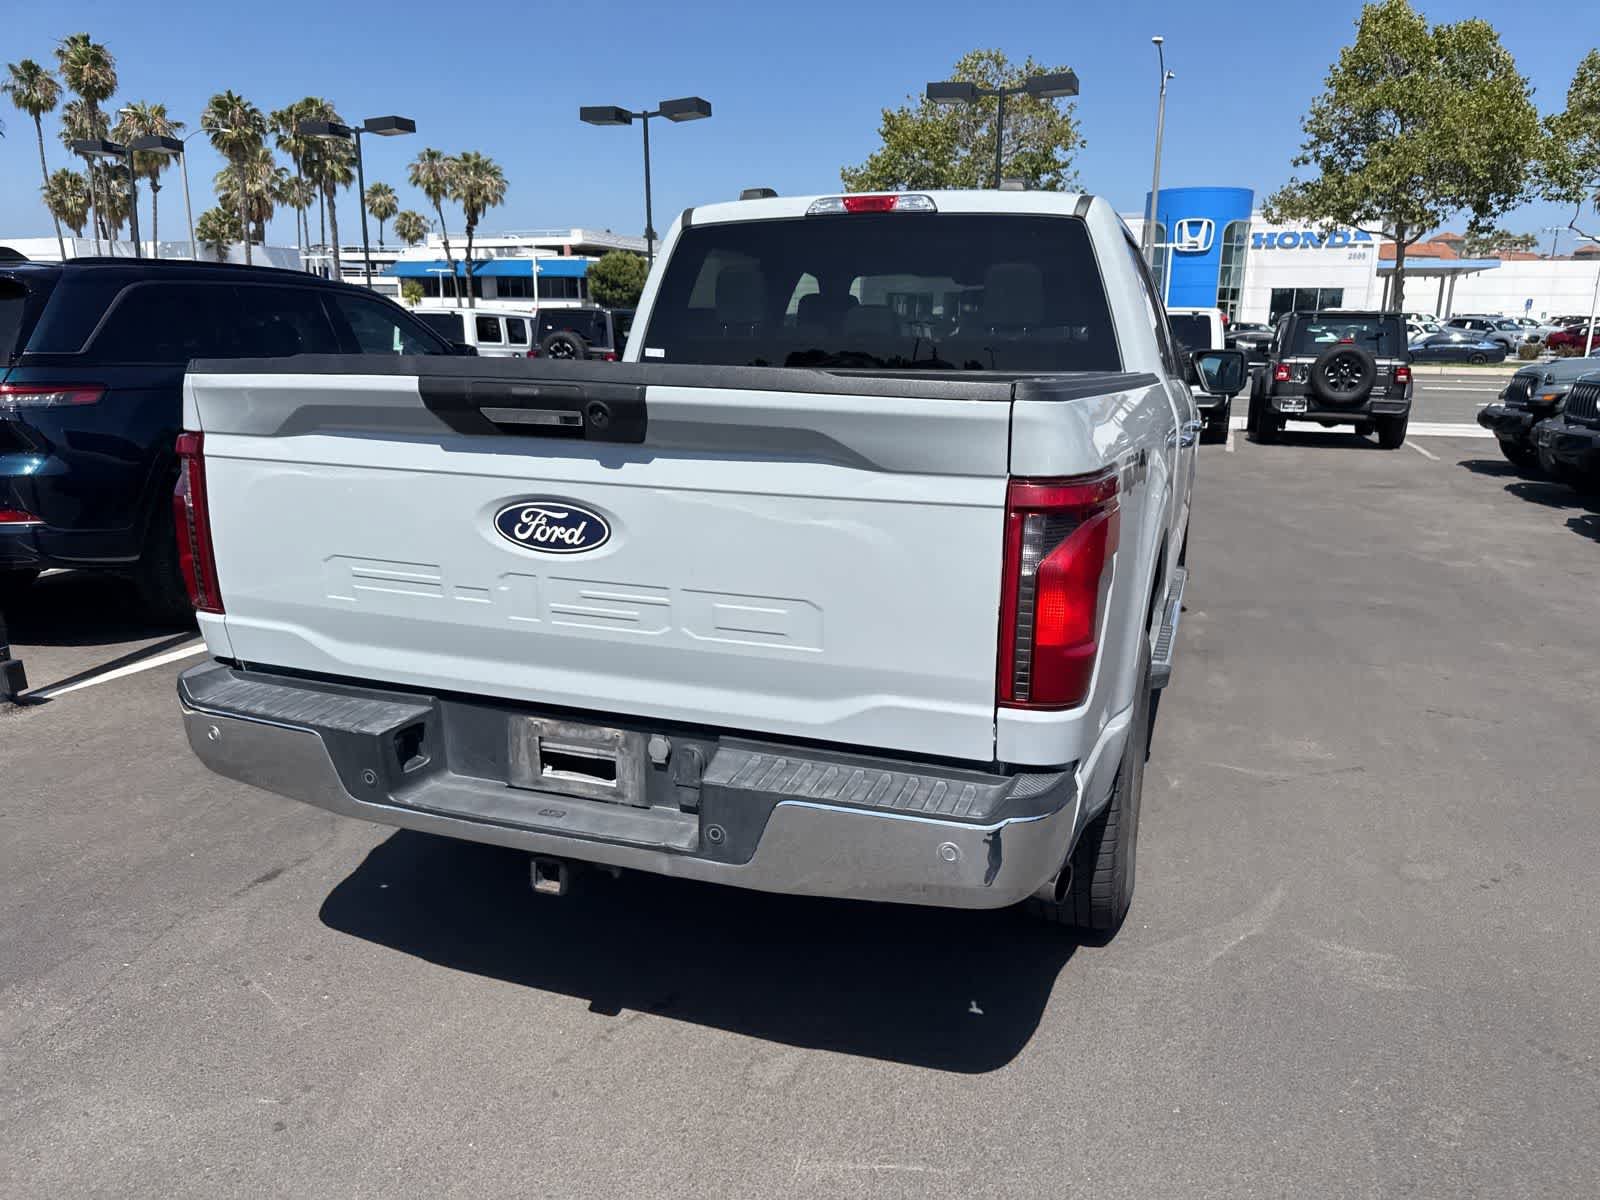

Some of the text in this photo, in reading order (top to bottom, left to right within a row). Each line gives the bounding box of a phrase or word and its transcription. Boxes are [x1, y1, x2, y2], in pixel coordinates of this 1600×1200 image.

[1251, 230, 1375, 249] HONDA
[514, 507, 587, 545] Ford
[323, 554, 825, 652] F-150
